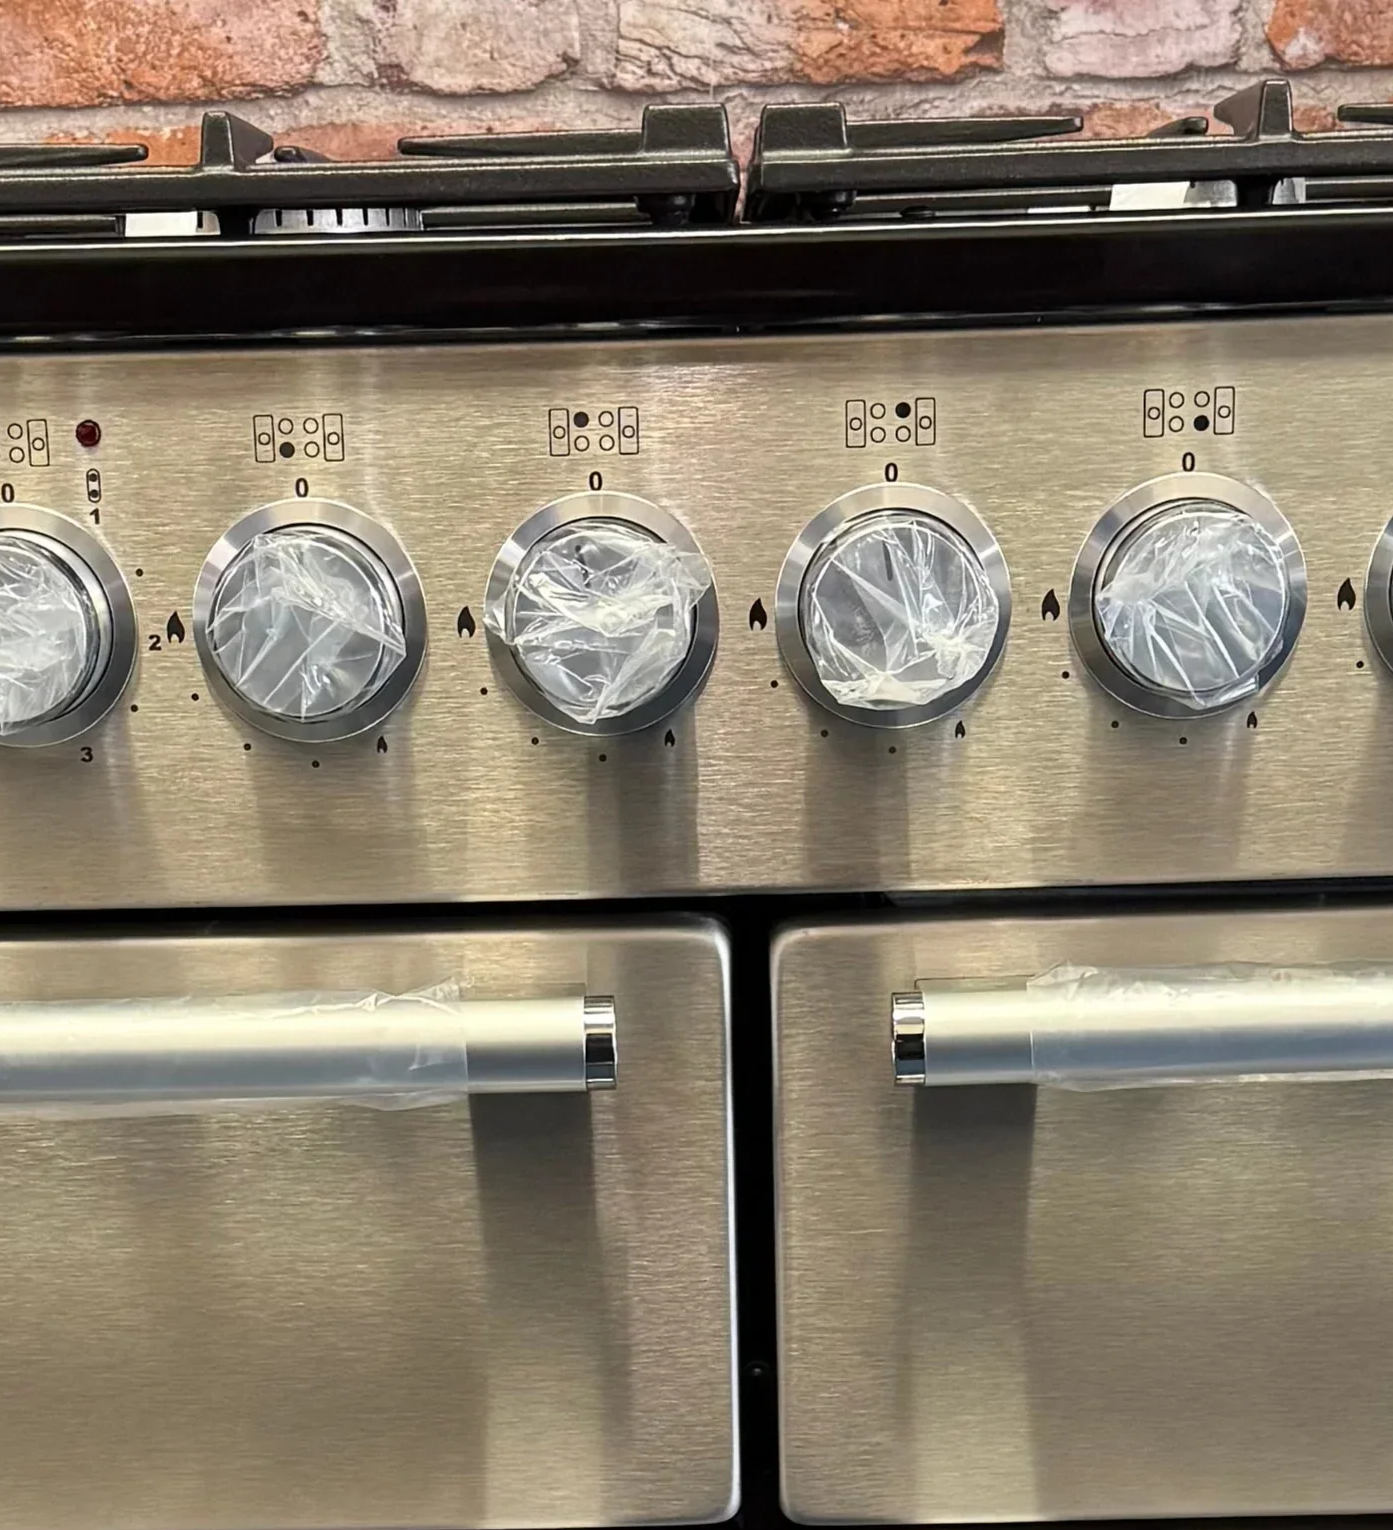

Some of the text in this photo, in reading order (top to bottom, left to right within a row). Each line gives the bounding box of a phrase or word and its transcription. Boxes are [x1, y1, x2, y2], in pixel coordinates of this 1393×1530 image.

[1181, 451, 1196, 473] 0
[589, 471, 603, 491] 0
[884, 463, 898, 483] 0
[1, 483, 15, 504] 0
[295, 478, 309, 499] 0
[90, 509, 101, 526] 1
[148, 635, 163, 652] 2
[80, 747, 94, 763] 3
